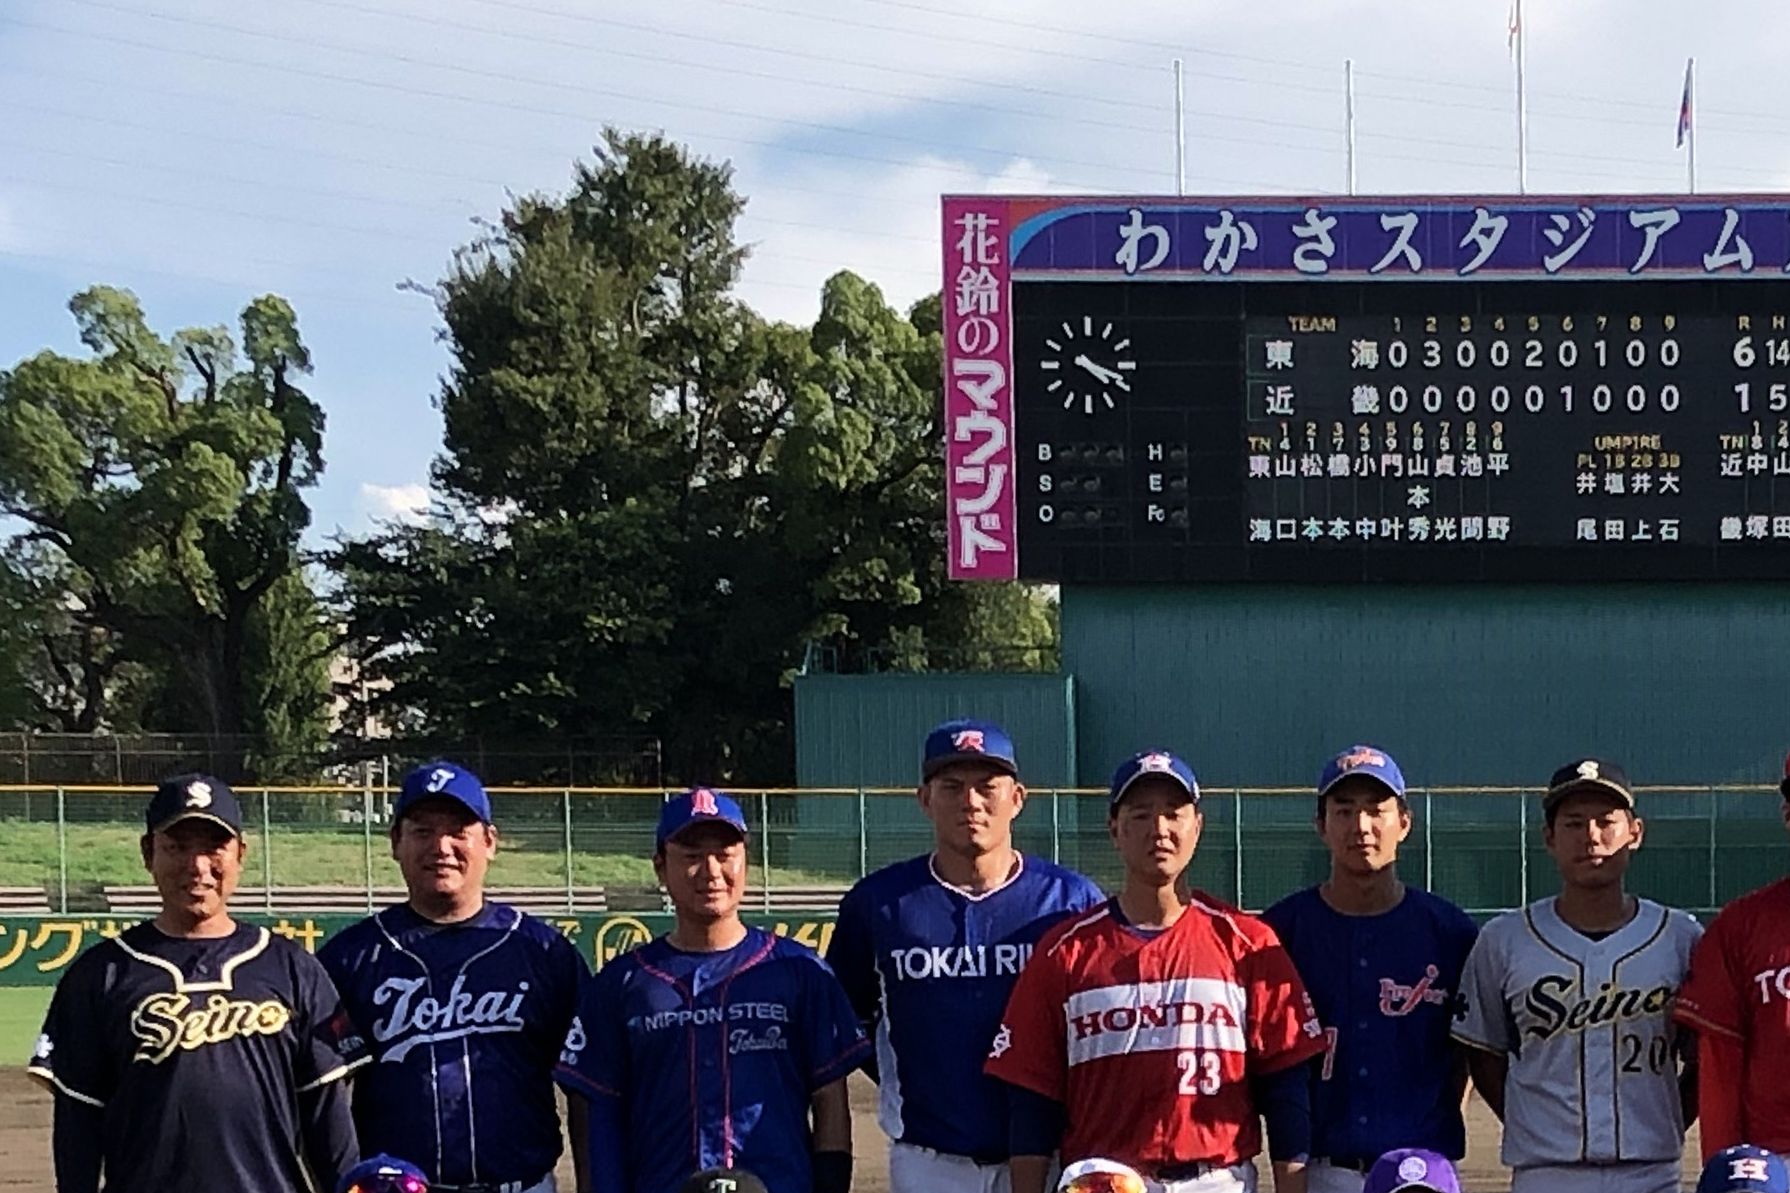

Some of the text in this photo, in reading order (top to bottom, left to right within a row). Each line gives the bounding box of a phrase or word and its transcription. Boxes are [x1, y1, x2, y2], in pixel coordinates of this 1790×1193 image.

[1289, 316, 1336, 332] TEAM
[1733, 336, 1755, 367] 6
[1766, 338, 1790, 366] 14
[954, 211, 1007, 571] 花鈴のマウンド
[1734, 382, 1750, 412] 1
[1769, 384, 1787, 411] 5
[1038, 443, 1052, 461] B
[1148, 443, 1163, 461] H
[1039, 474, 1052, 492] S
[1149, 474, 1163, 492] E
[185, 781, 212, 808] S
[892, 944, 986, 980] TOKAI
[373, 973, 531, 1043] Tokai
[644, 1002, 789, 1031] NIPPON STEEL
[1072, 1000, 1238, 1042] HONDA
[1526, 975, 1674, 1039] Seino
[131, 993, 289, 1065] Seino
[1622, 1034, 1668, 1076] 20
[1177, 1051, 1221, 1096] 23
